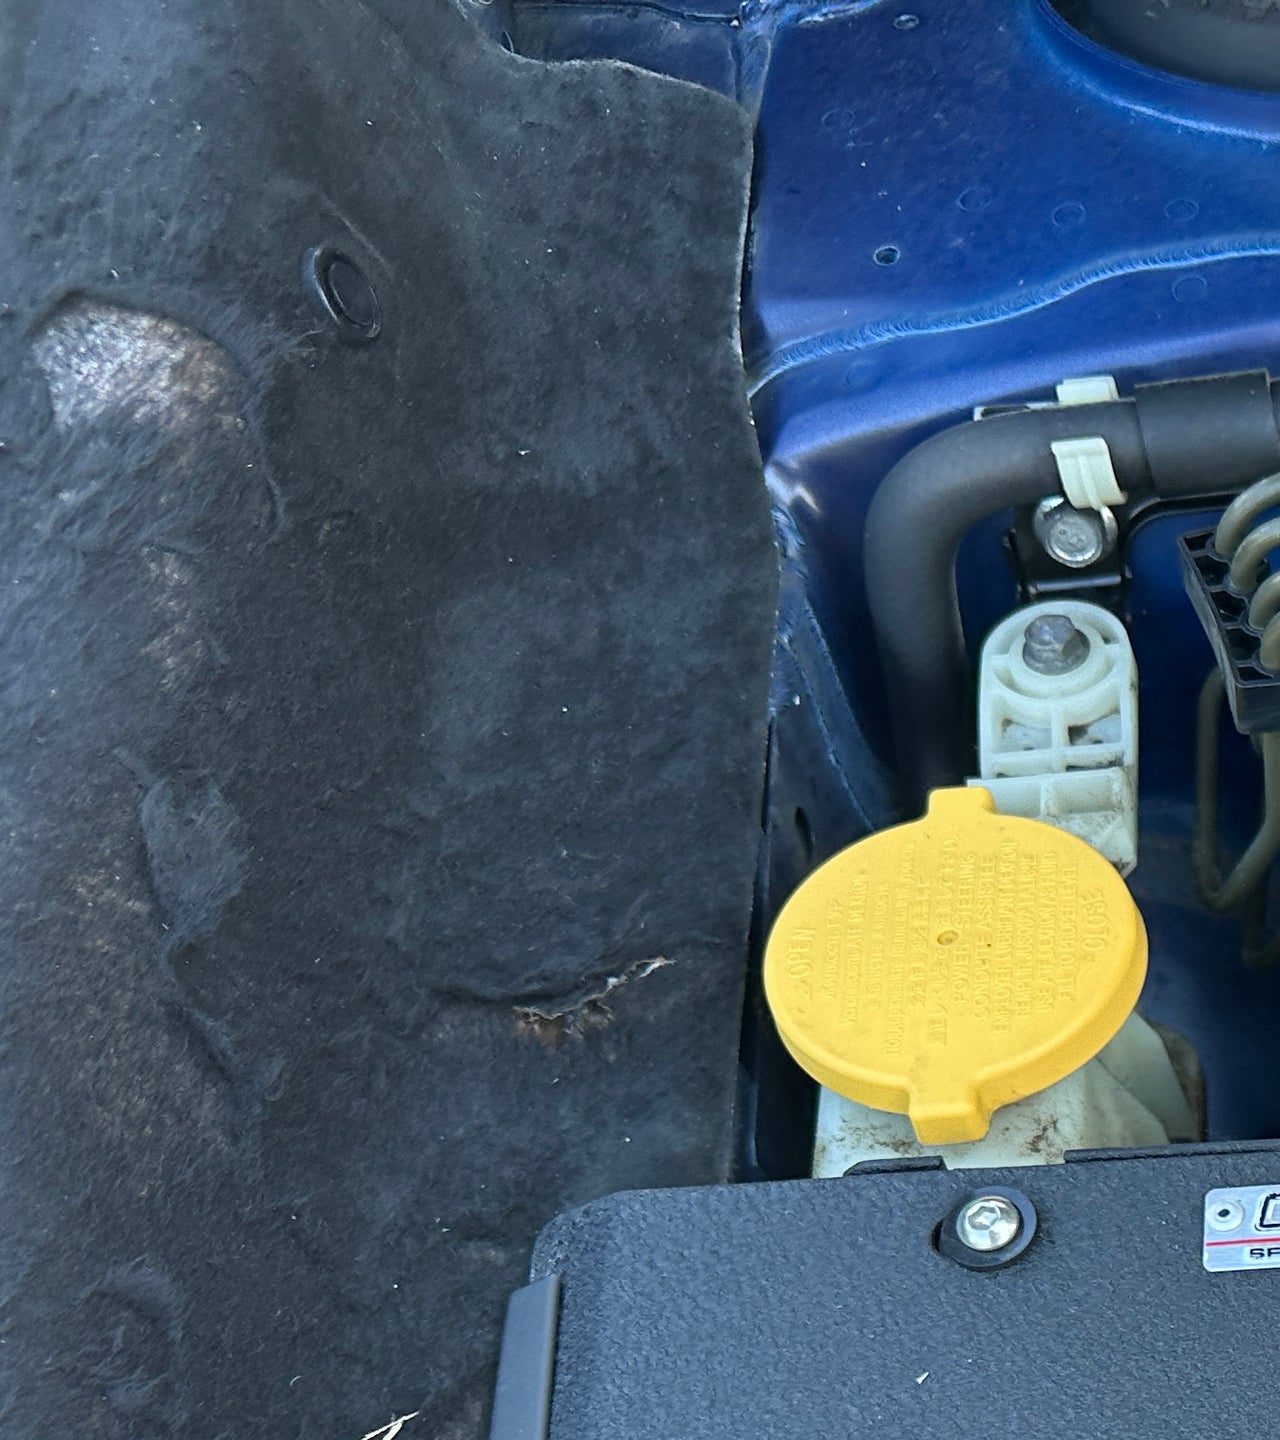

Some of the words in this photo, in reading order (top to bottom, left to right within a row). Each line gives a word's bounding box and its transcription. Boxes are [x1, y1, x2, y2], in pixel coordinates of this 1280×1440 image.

[954, 852, 978, 931] STEERING
[1080, 891, 1109, 953] CLOSE
[786, 927, 817, 979] OPEN
[952, 943, 971, 1004] POWER
[993, 963, 1013, 1034] EMPLOYER
[1037, 990, 1055, 1014] USE
